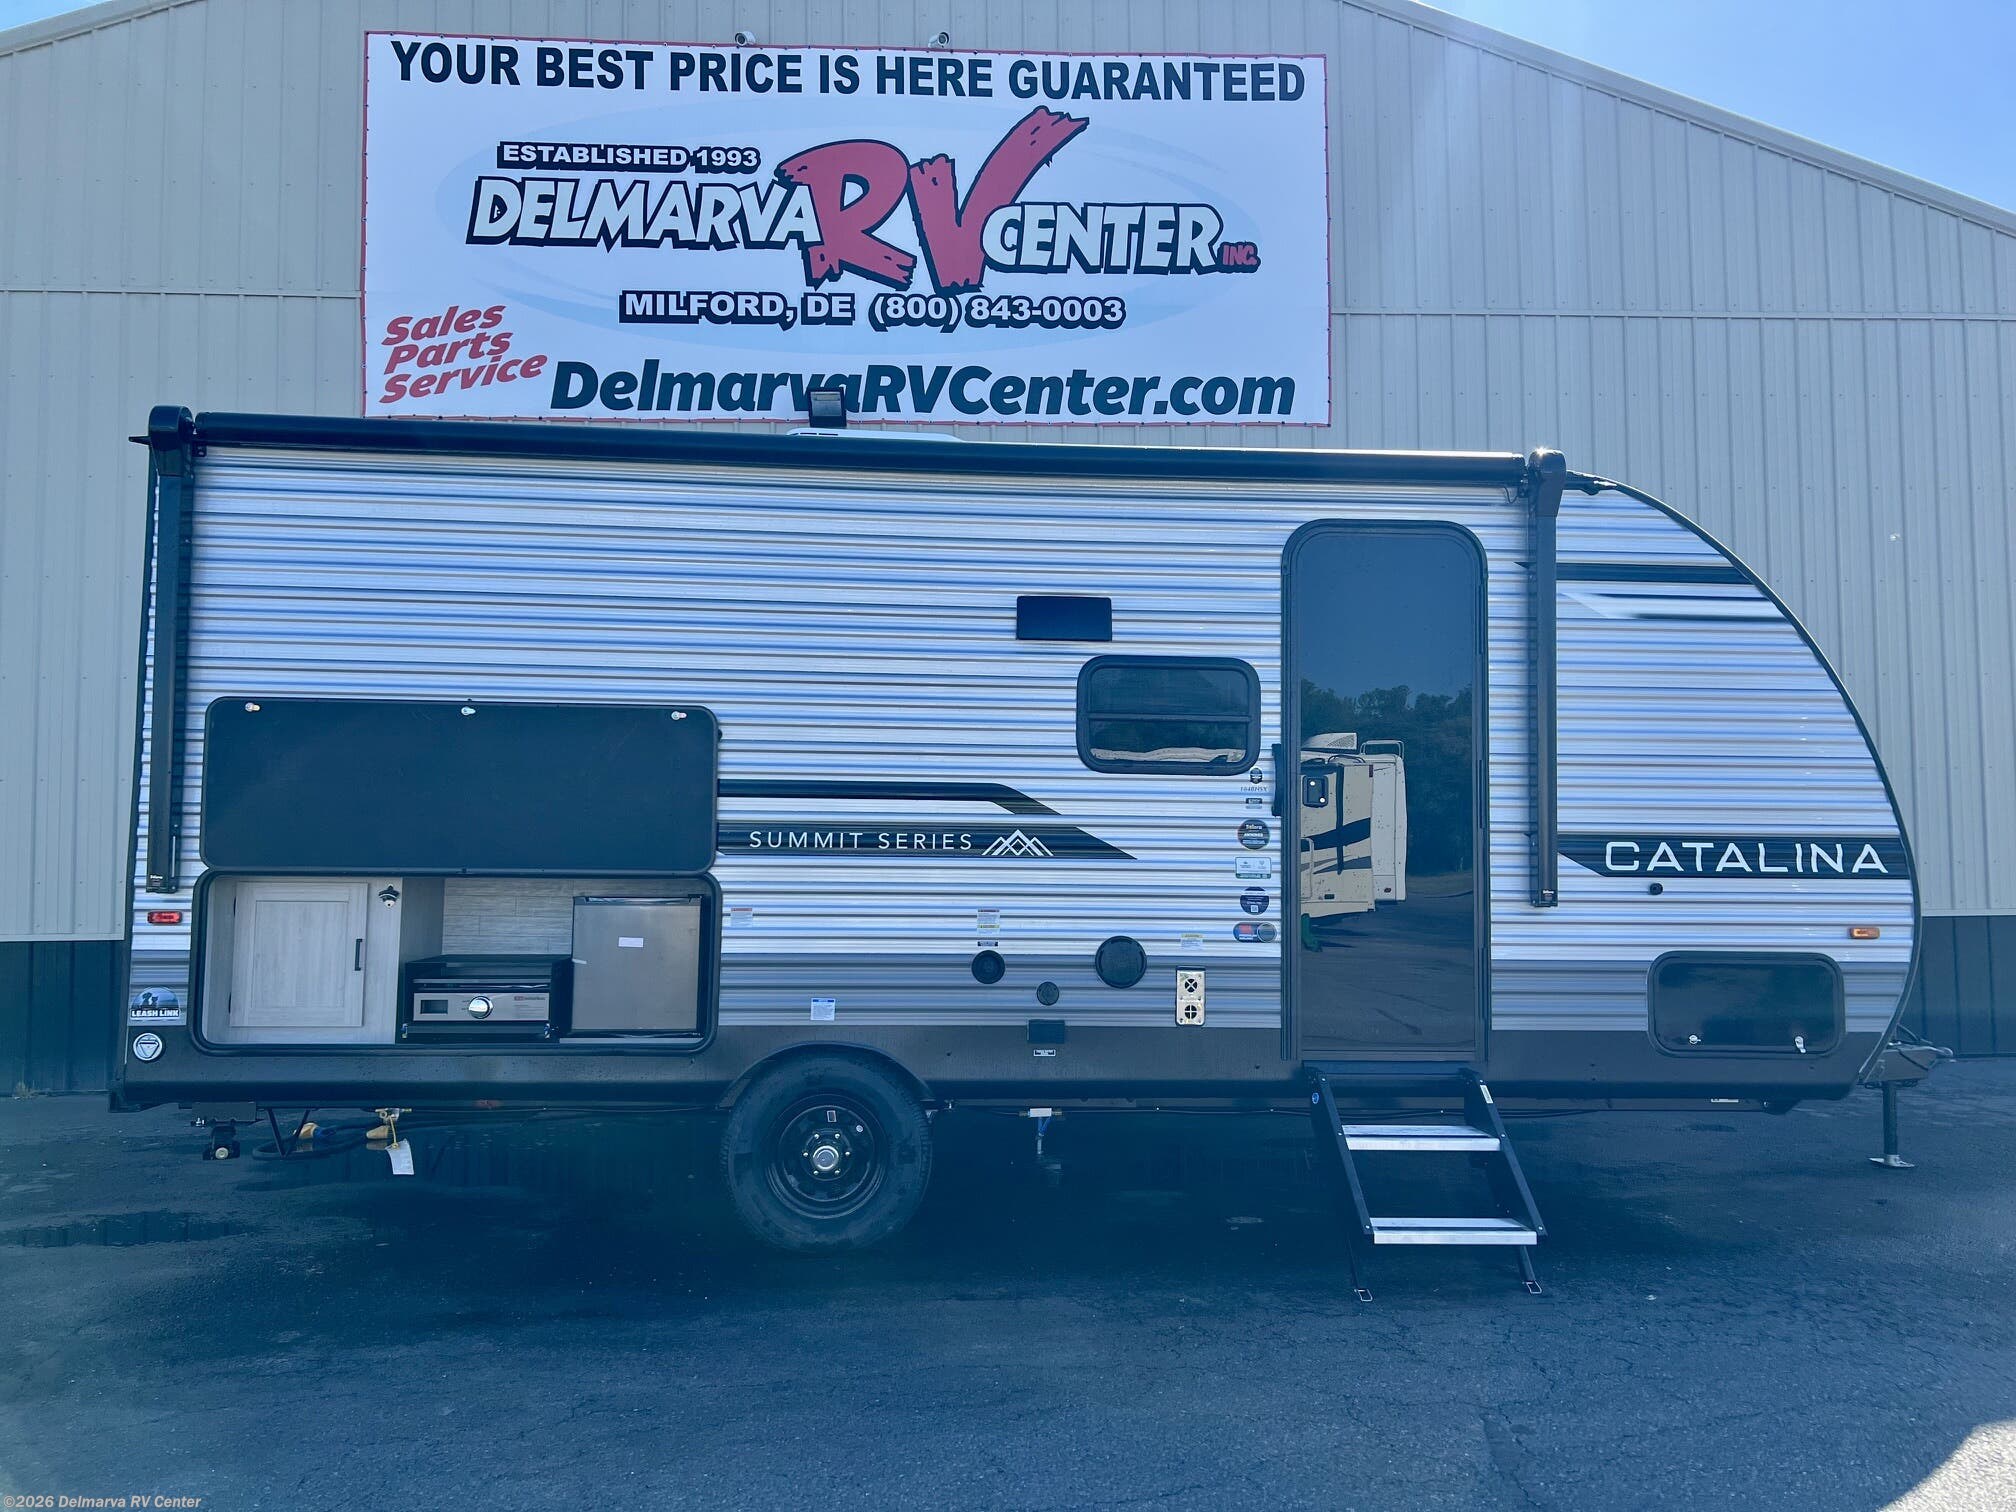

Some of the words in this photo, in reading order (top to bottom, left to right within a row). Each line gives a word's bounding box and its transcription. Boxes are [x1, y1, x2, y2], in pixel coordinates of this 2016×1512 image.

[391, 40, 521, 86] YOUR
[536, 47, 654, 91] BEST
[669, 51, 803, 94] PRICE
[819, 54, 861, 95] IS
[876, 55, 993, 98] HERE
[1008, 59, 1306, 102] GUARANTEED
[502, 145, 688, 167] ESTABLISHED
[696, 148, 759, 169] 1993
[468, 176, 825, 247] DELMARVA
[774, 105, 1089, 294] RV
[981, 202, 1221, 272] CENTER
[381, 305, 507, 346] Sales
[625, 292, 795, 323] MILFORD,
[806, 296, 852, 318] DE
[874, 296, 959, 327] (800)
[970, 298, 1124, 323] 843-0003
[384, 332, 513, 375] Parts
[379, 354, 548, 404] Service
[550, 359, 1296, 415] DelmarvaRVCenter.com
[749, 831, 864, 848] SUMMIT
[878, 833, 972, 849] SERIES
[1605, 841, 1888, 873] CATALINA
[131, 1009, 158, 1017] LEASH
